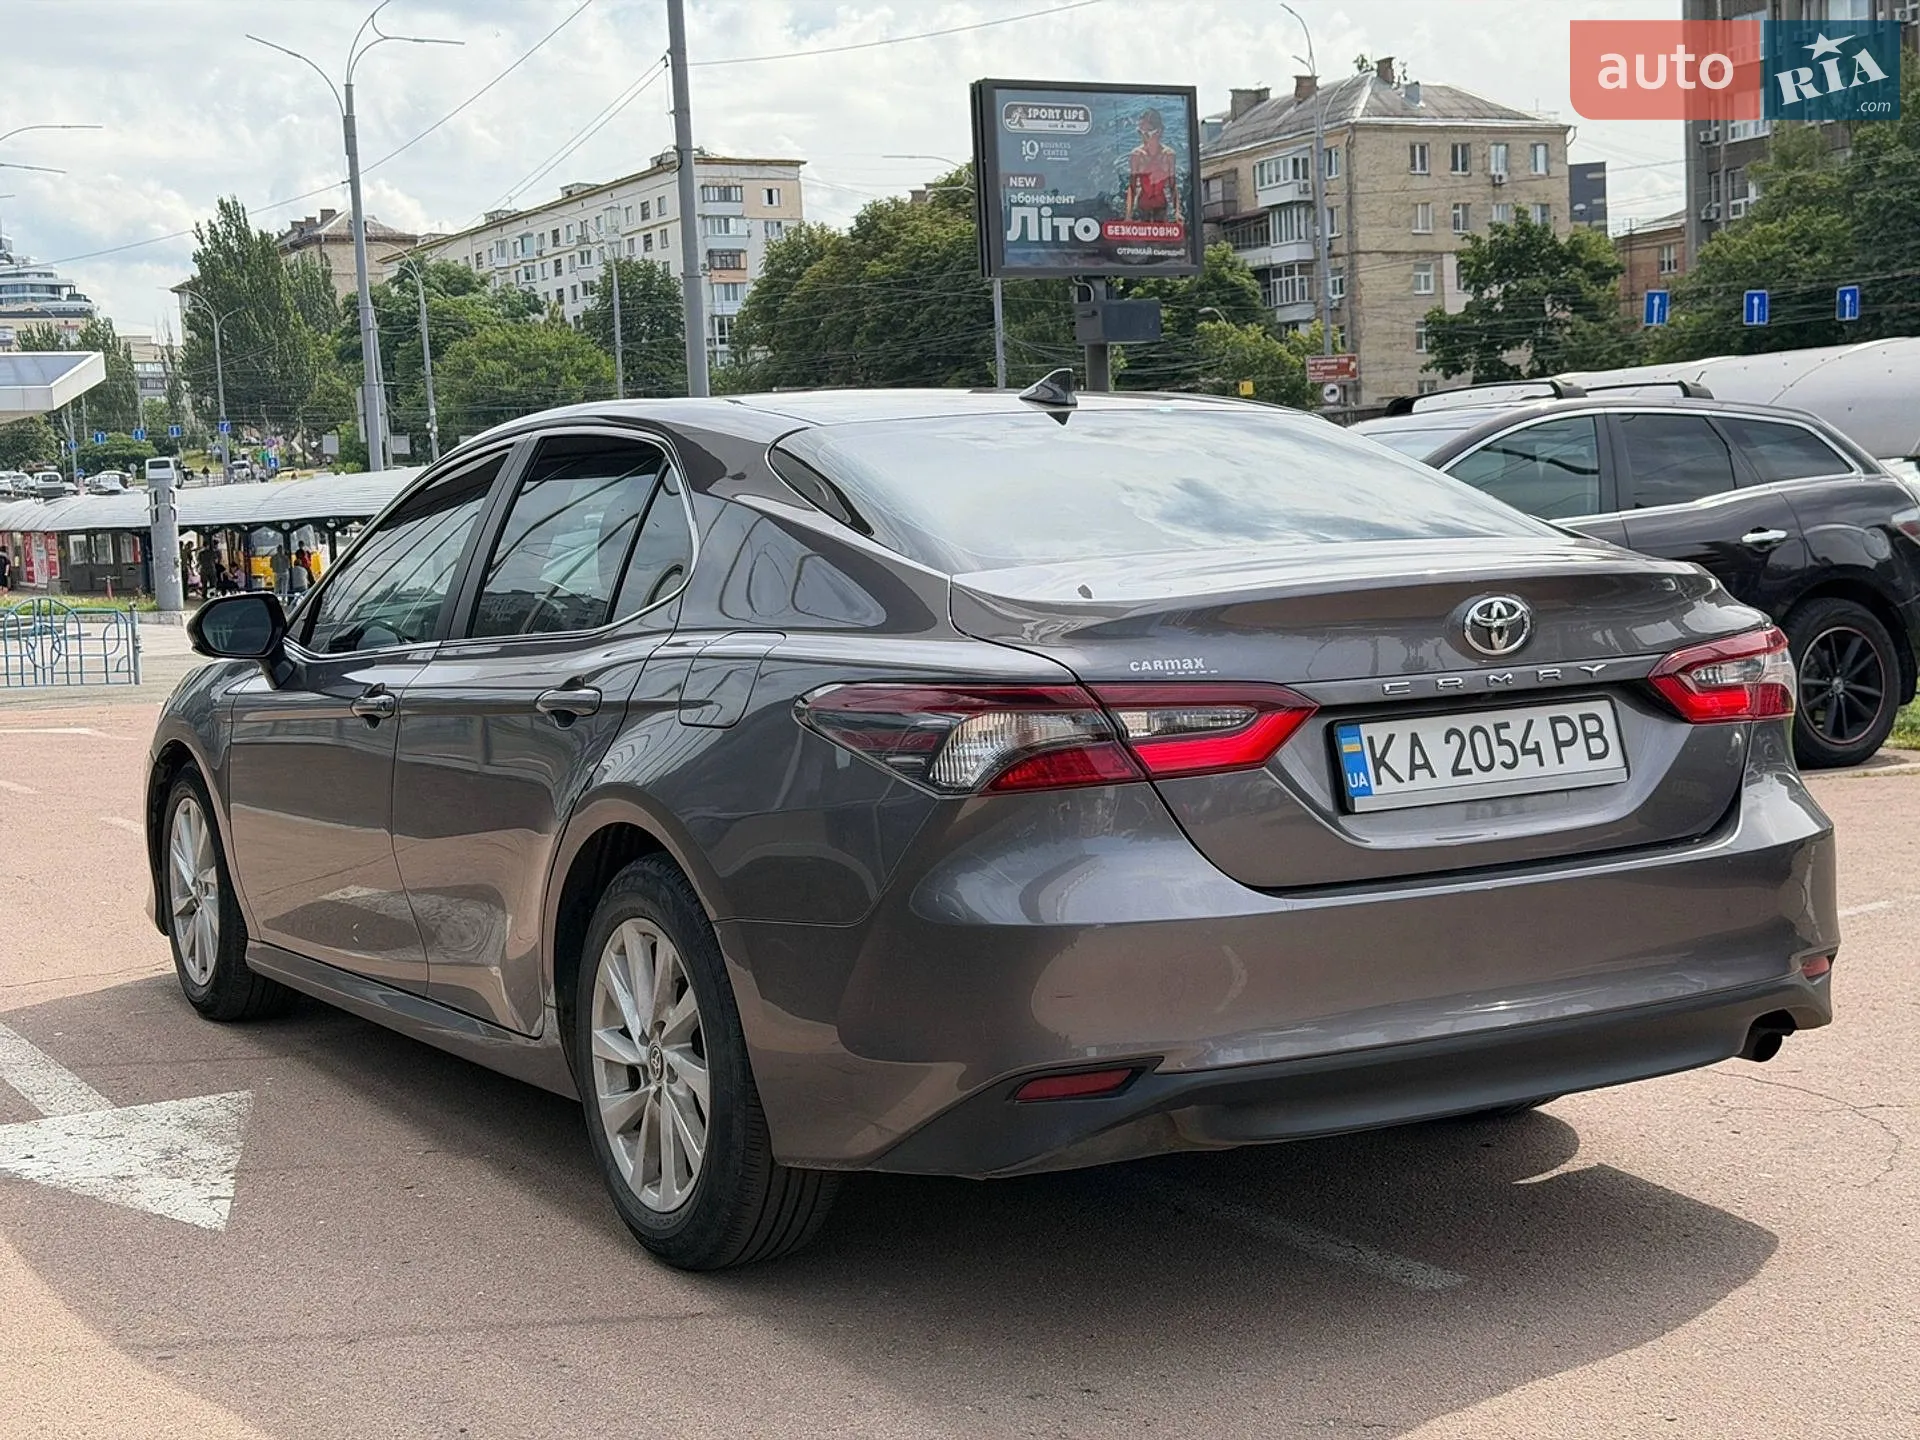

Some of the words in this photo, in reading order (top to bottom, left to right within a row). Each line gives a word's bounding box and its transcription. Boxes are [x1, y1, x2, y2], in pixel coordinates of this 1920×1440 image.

[1028, 107, 1061, 120] SPORT
[1009, 176, 1036, 188] NEW
[1010, 192, 1076, 204] абонемент
[1006, 206, 1100, 242] Літо
[1107, 225, 1180, 237] БЕЗКОШТОВНО
[1382, 664, 1606, 696] CAMRY
[1366, 732, 1437, 786] KA
[1444, 719, 1545, 777] 2054
[1548, 713, 1610, 765] PB
[1349, 771, 1369, 788] UA
